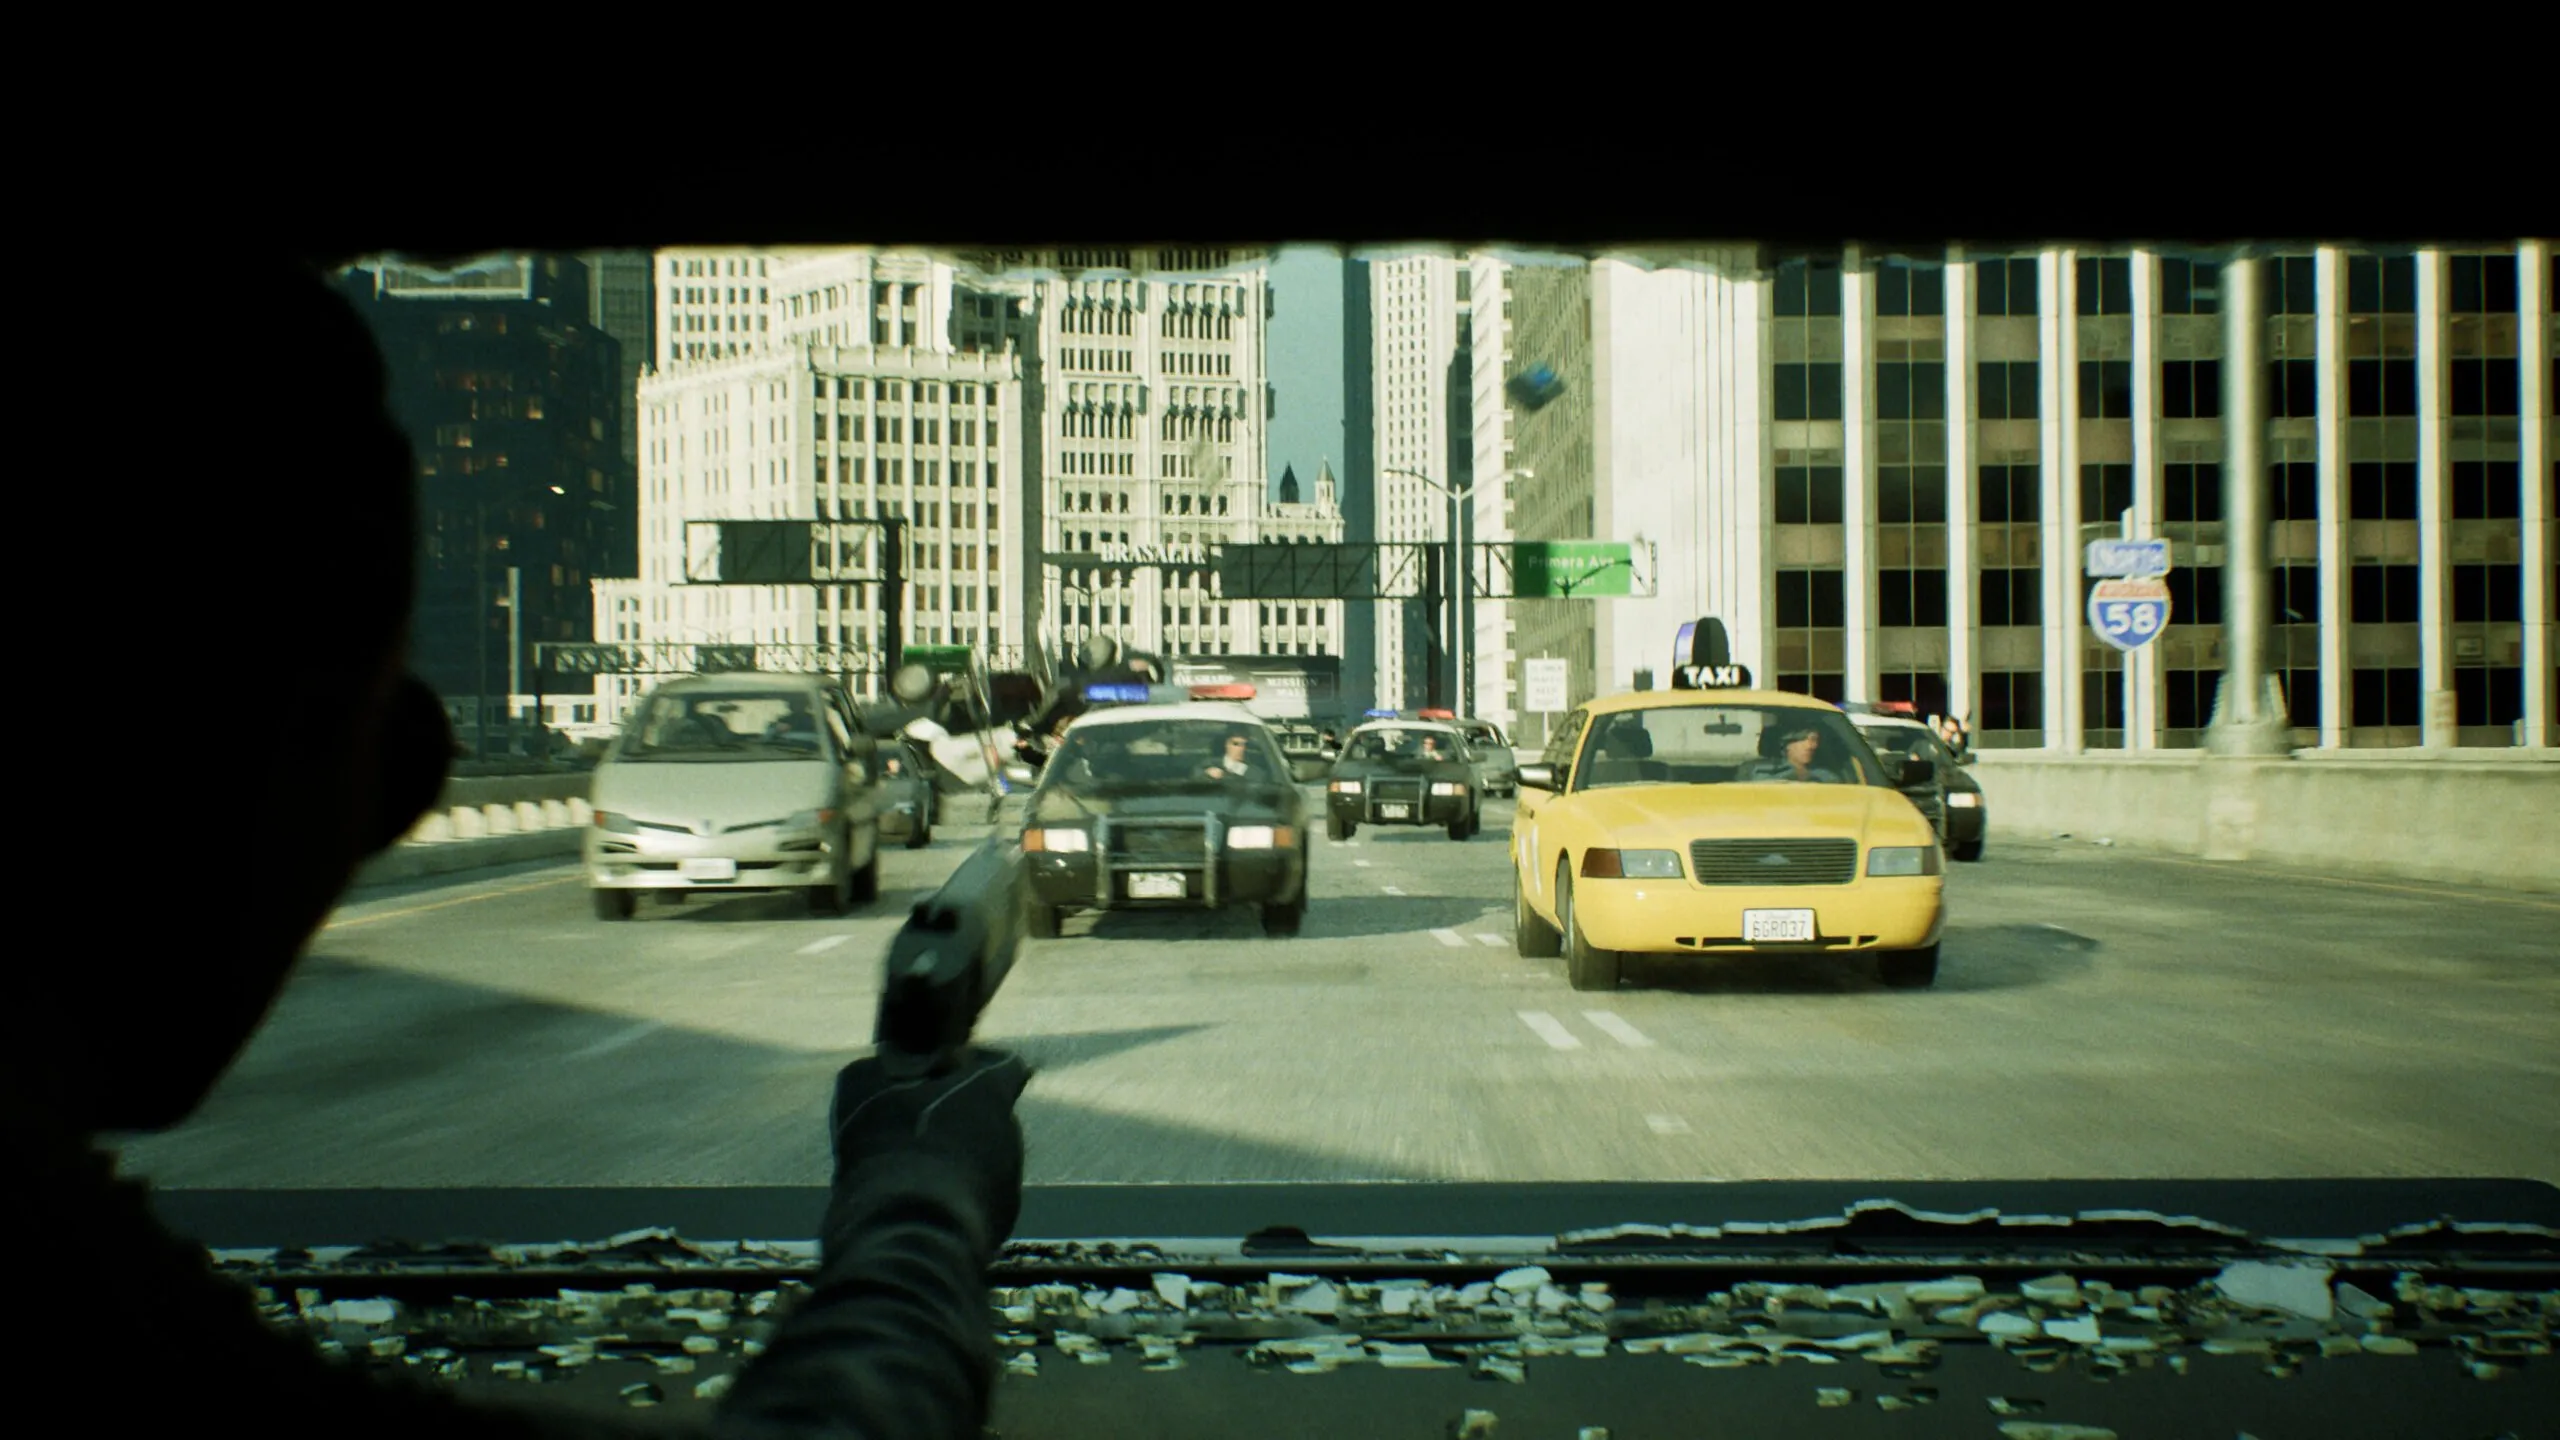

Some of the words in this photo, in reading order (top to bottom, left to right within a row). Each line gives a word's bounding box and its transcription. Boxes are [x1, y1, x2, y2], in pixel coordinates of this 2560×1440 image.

[1528, 555, 1585, 569] Primera
[2106, 603, 2157, 635] 58
[1683, 666, 1740, 687] TAXI
[1753, 920, 1806, 938] 6GR037
